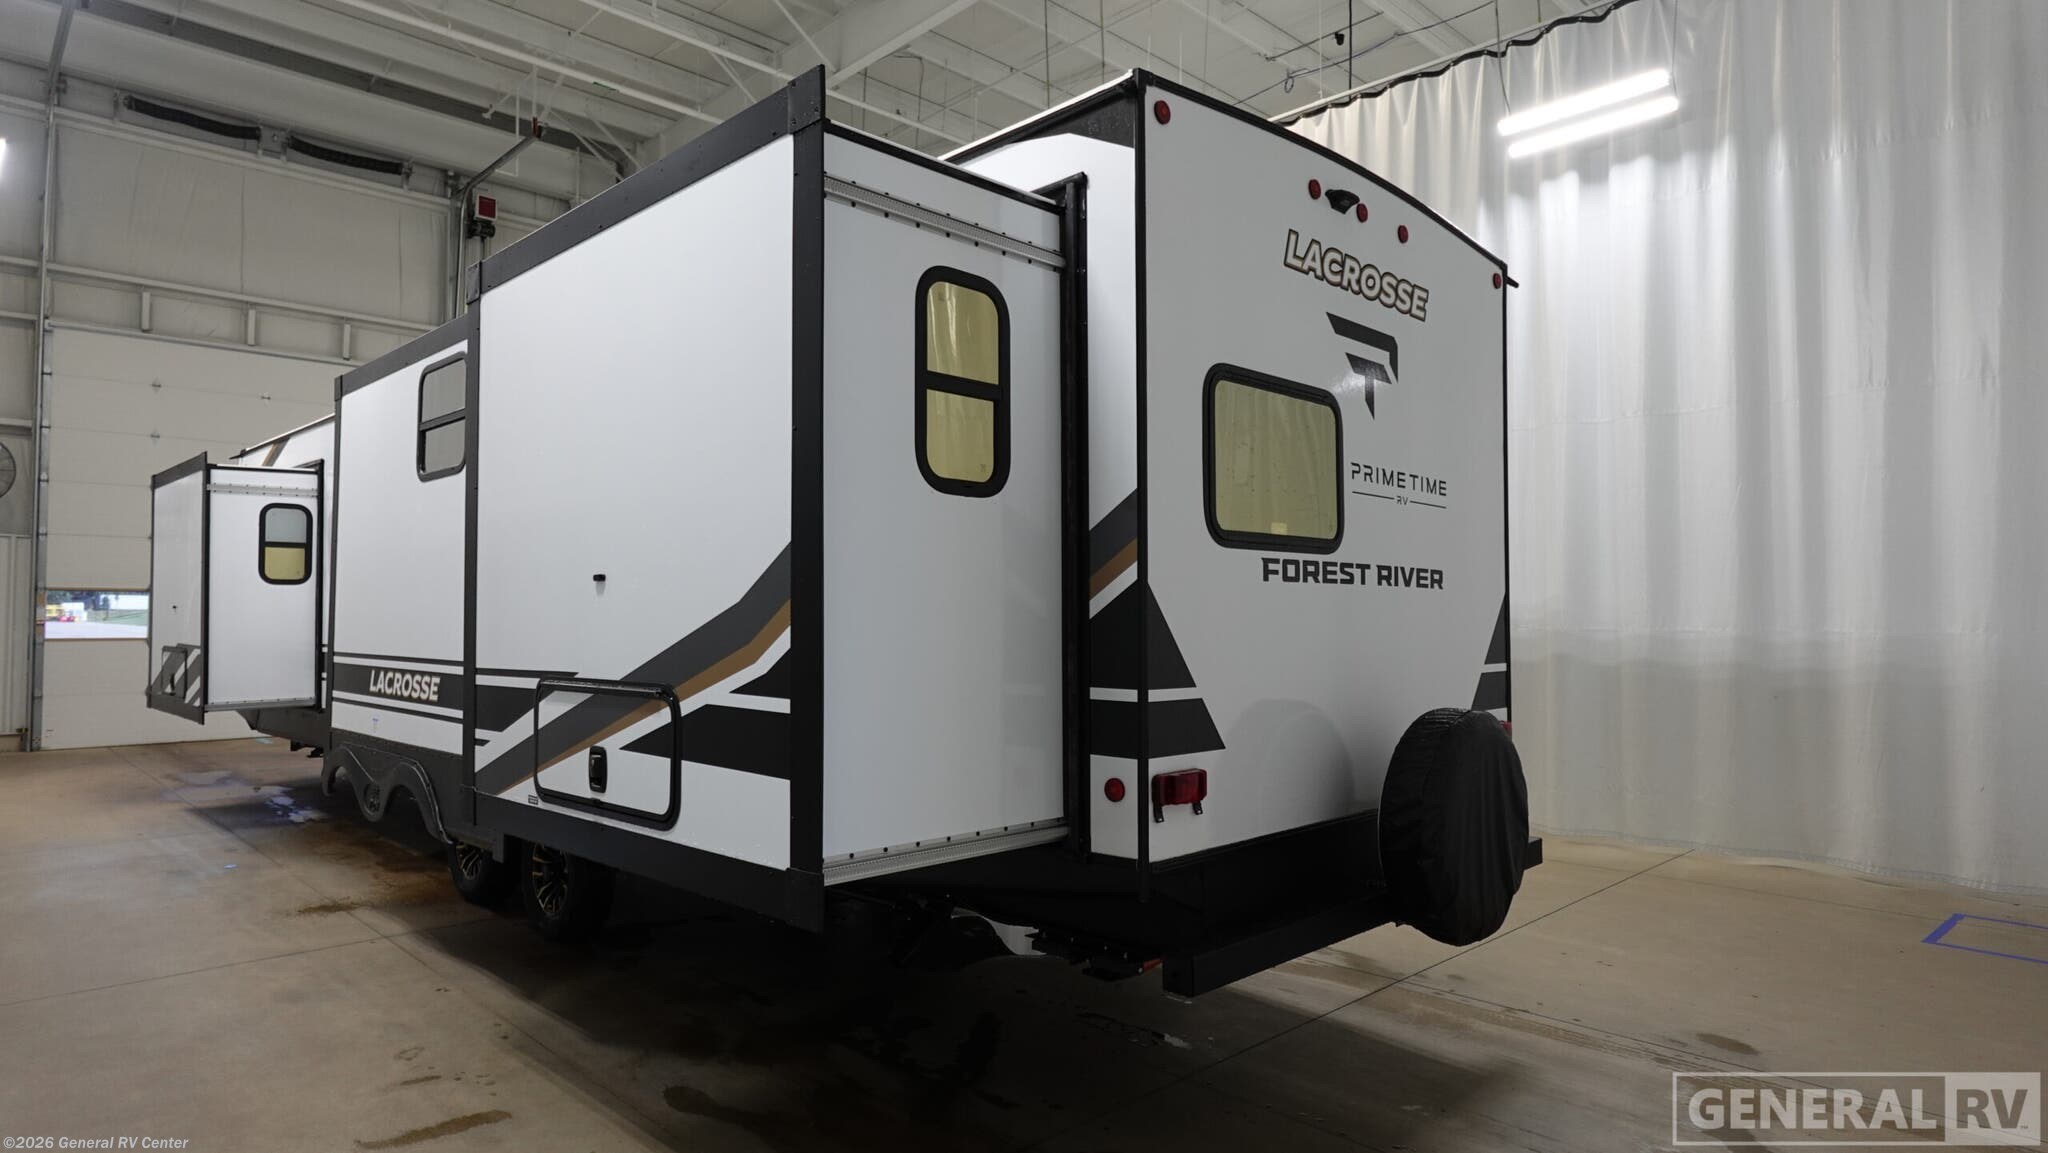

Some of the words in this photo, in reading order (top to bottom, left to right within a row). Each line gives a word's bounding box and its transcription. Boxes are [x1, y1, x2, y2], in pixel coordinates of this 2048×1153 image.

[1284, 229, 1429, 322] LACROSSE
[1396, 496, 1409, 506] RV
[1261, 557, 1371, 586] FOREST
[1376, 564, 1444, 590] RIVER
[369, 669, 441, 702] LACROSSE
